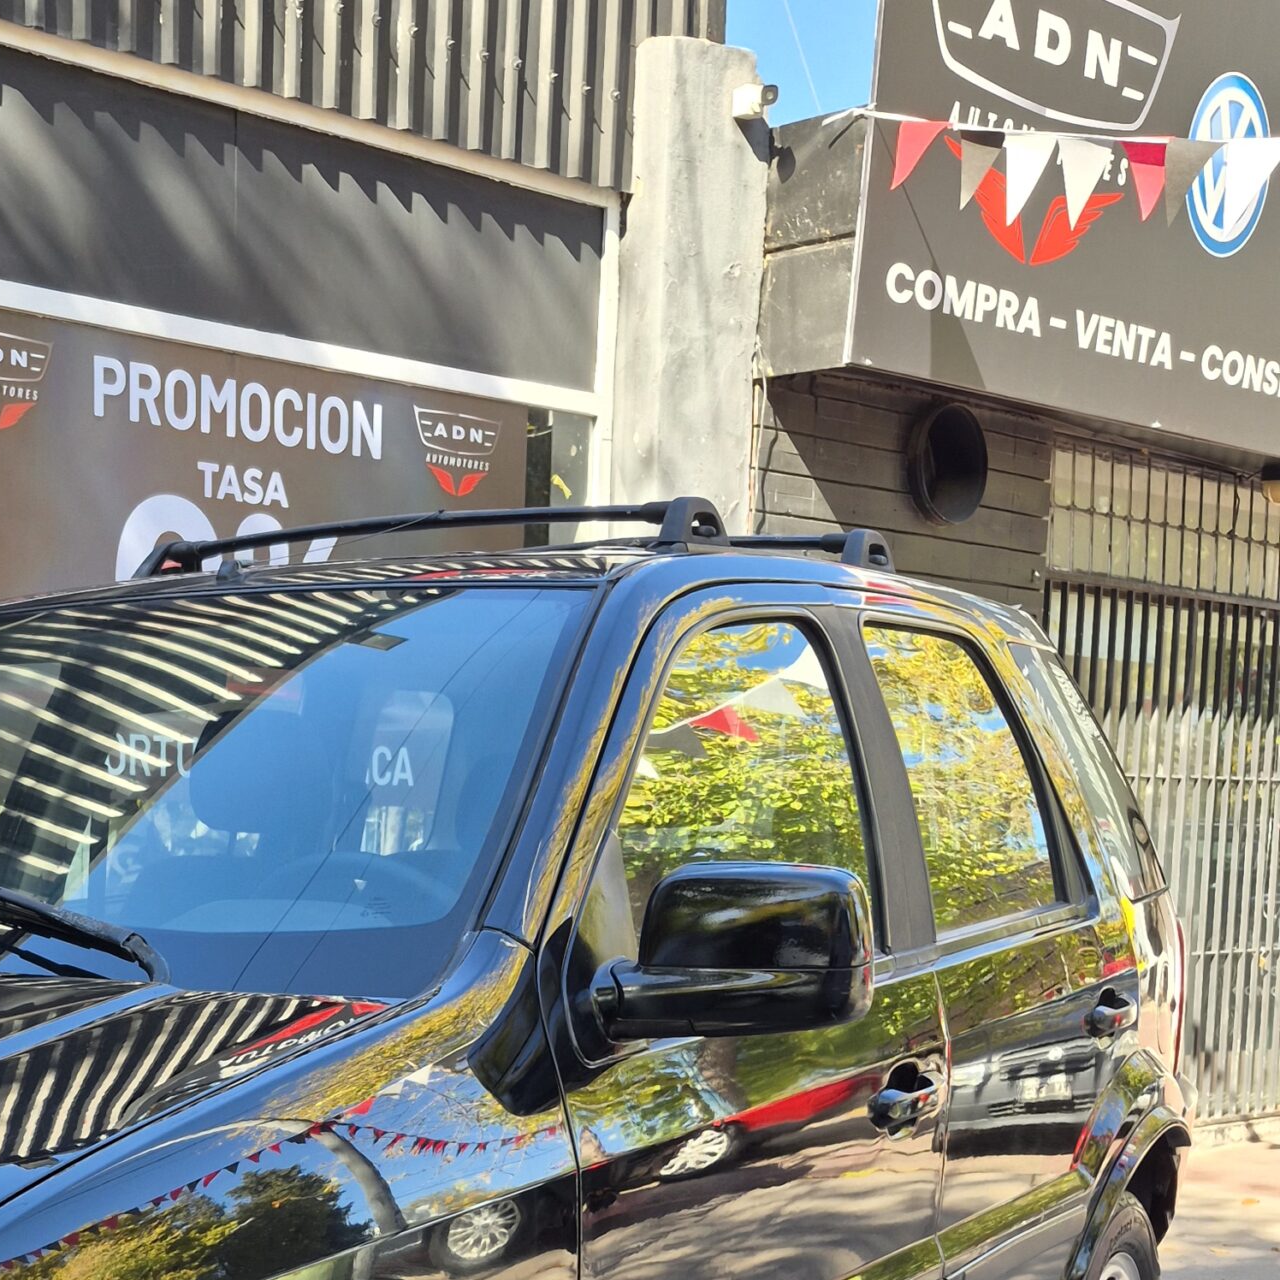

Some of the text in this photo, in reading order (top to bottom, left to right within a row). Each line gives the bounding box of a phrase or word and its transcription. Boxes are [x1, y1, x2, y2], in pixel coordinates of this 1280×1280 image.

[978, 0, 1122, 87] ADN
[885, 262, 1041, 337] COMPRA
[1075, 309, 1172, 370] VENTA
[1201, 345, 1280, 397] CONS
[93, 355, 383, 460] PROMOCION
[434, 422, 483, 444] ADN
[197, 461, 289, 508] TASA
[426, 453, 490, 471] AUTOMOTORES
